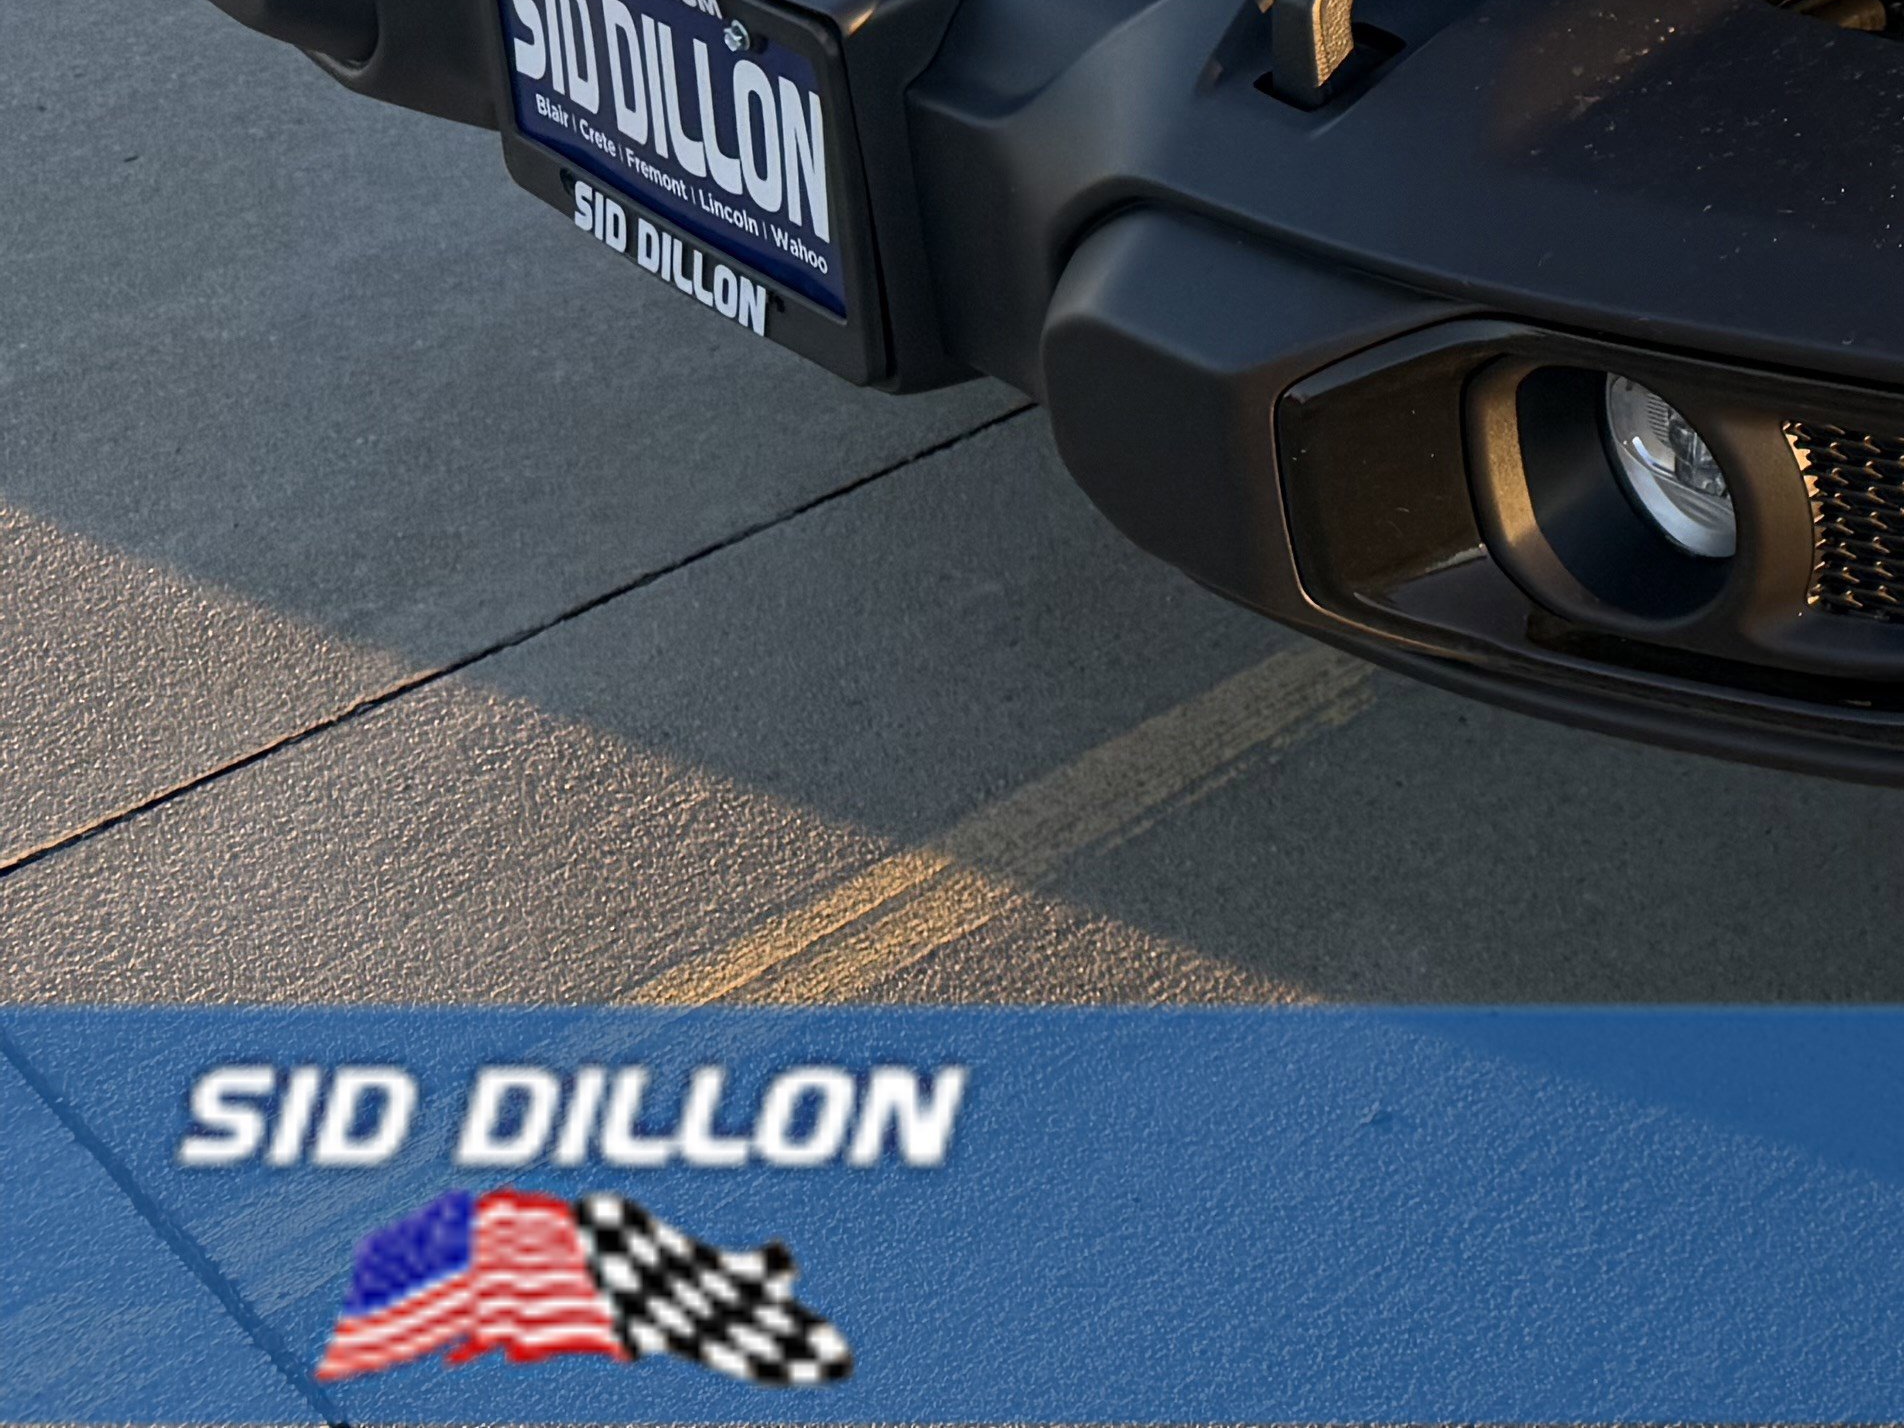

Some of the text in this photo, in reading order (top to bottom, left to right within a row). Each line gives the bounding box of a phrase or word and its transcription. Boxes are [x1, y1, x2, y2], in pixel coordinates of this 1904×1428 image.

[535, 93, 829, 275] Blair Crete Fremont Lincoln Wahoo
[574, 180, 767, 337] SID DILLON
